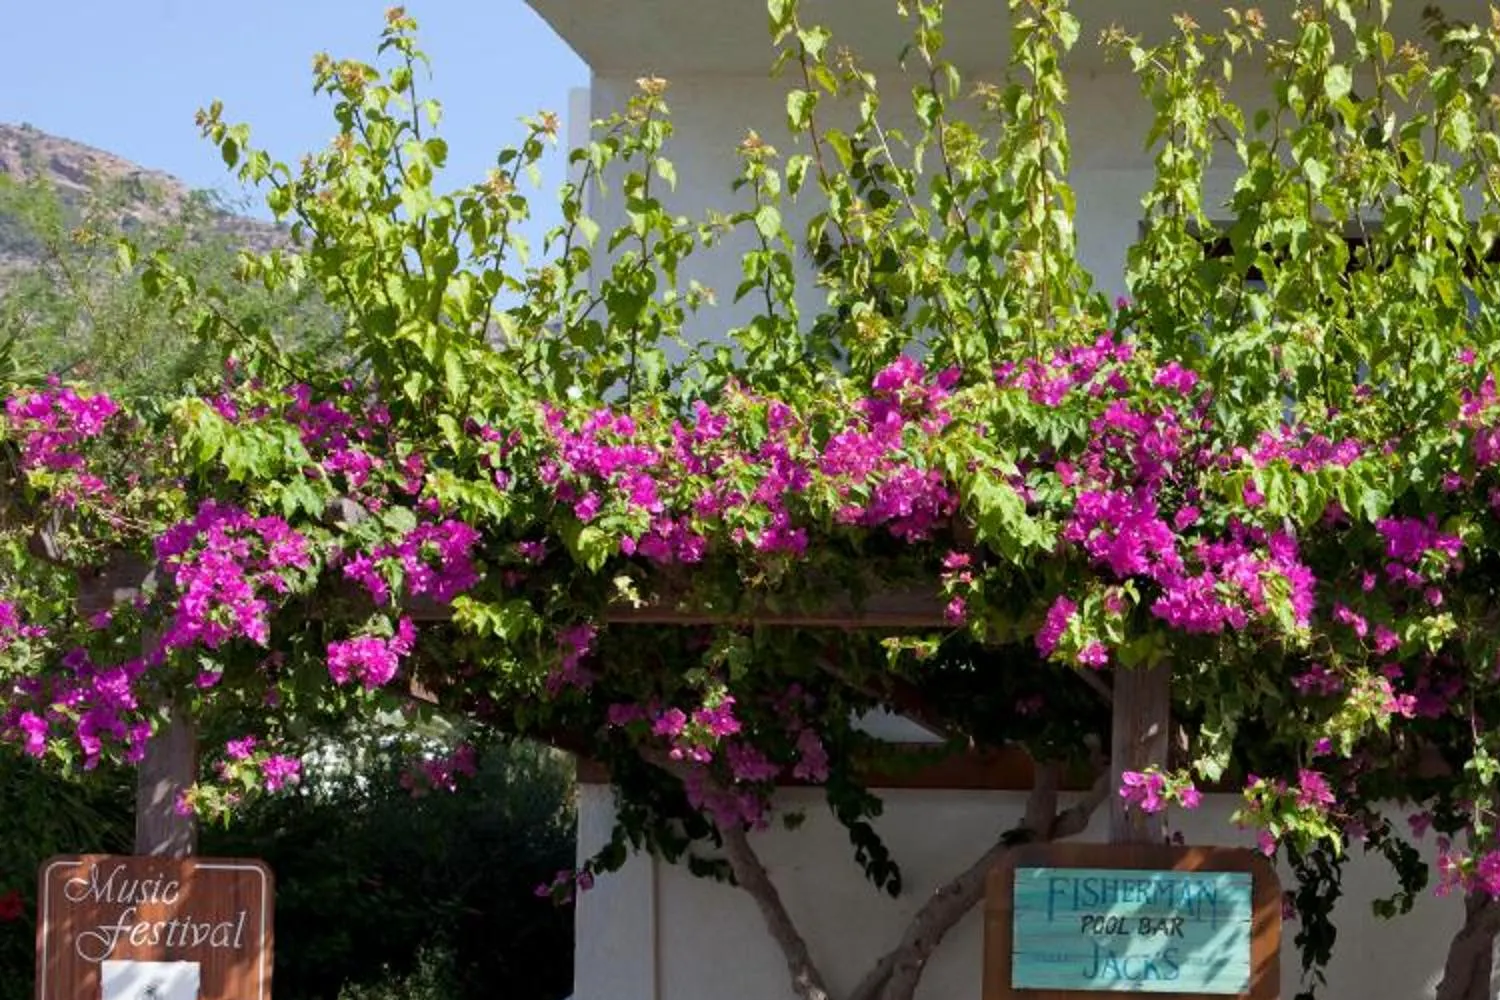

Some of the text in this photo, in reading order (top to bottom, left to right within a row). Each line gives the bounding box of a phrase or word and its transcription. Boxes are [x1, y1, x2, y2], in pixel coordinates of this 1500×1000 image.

[64, 864, 181, 904] Music
[1047, 876, 1218, 929] FISHERMAN
[76, 907, 248, 963] Festival
[1081, 914, 1185, 938] POOL BAR
